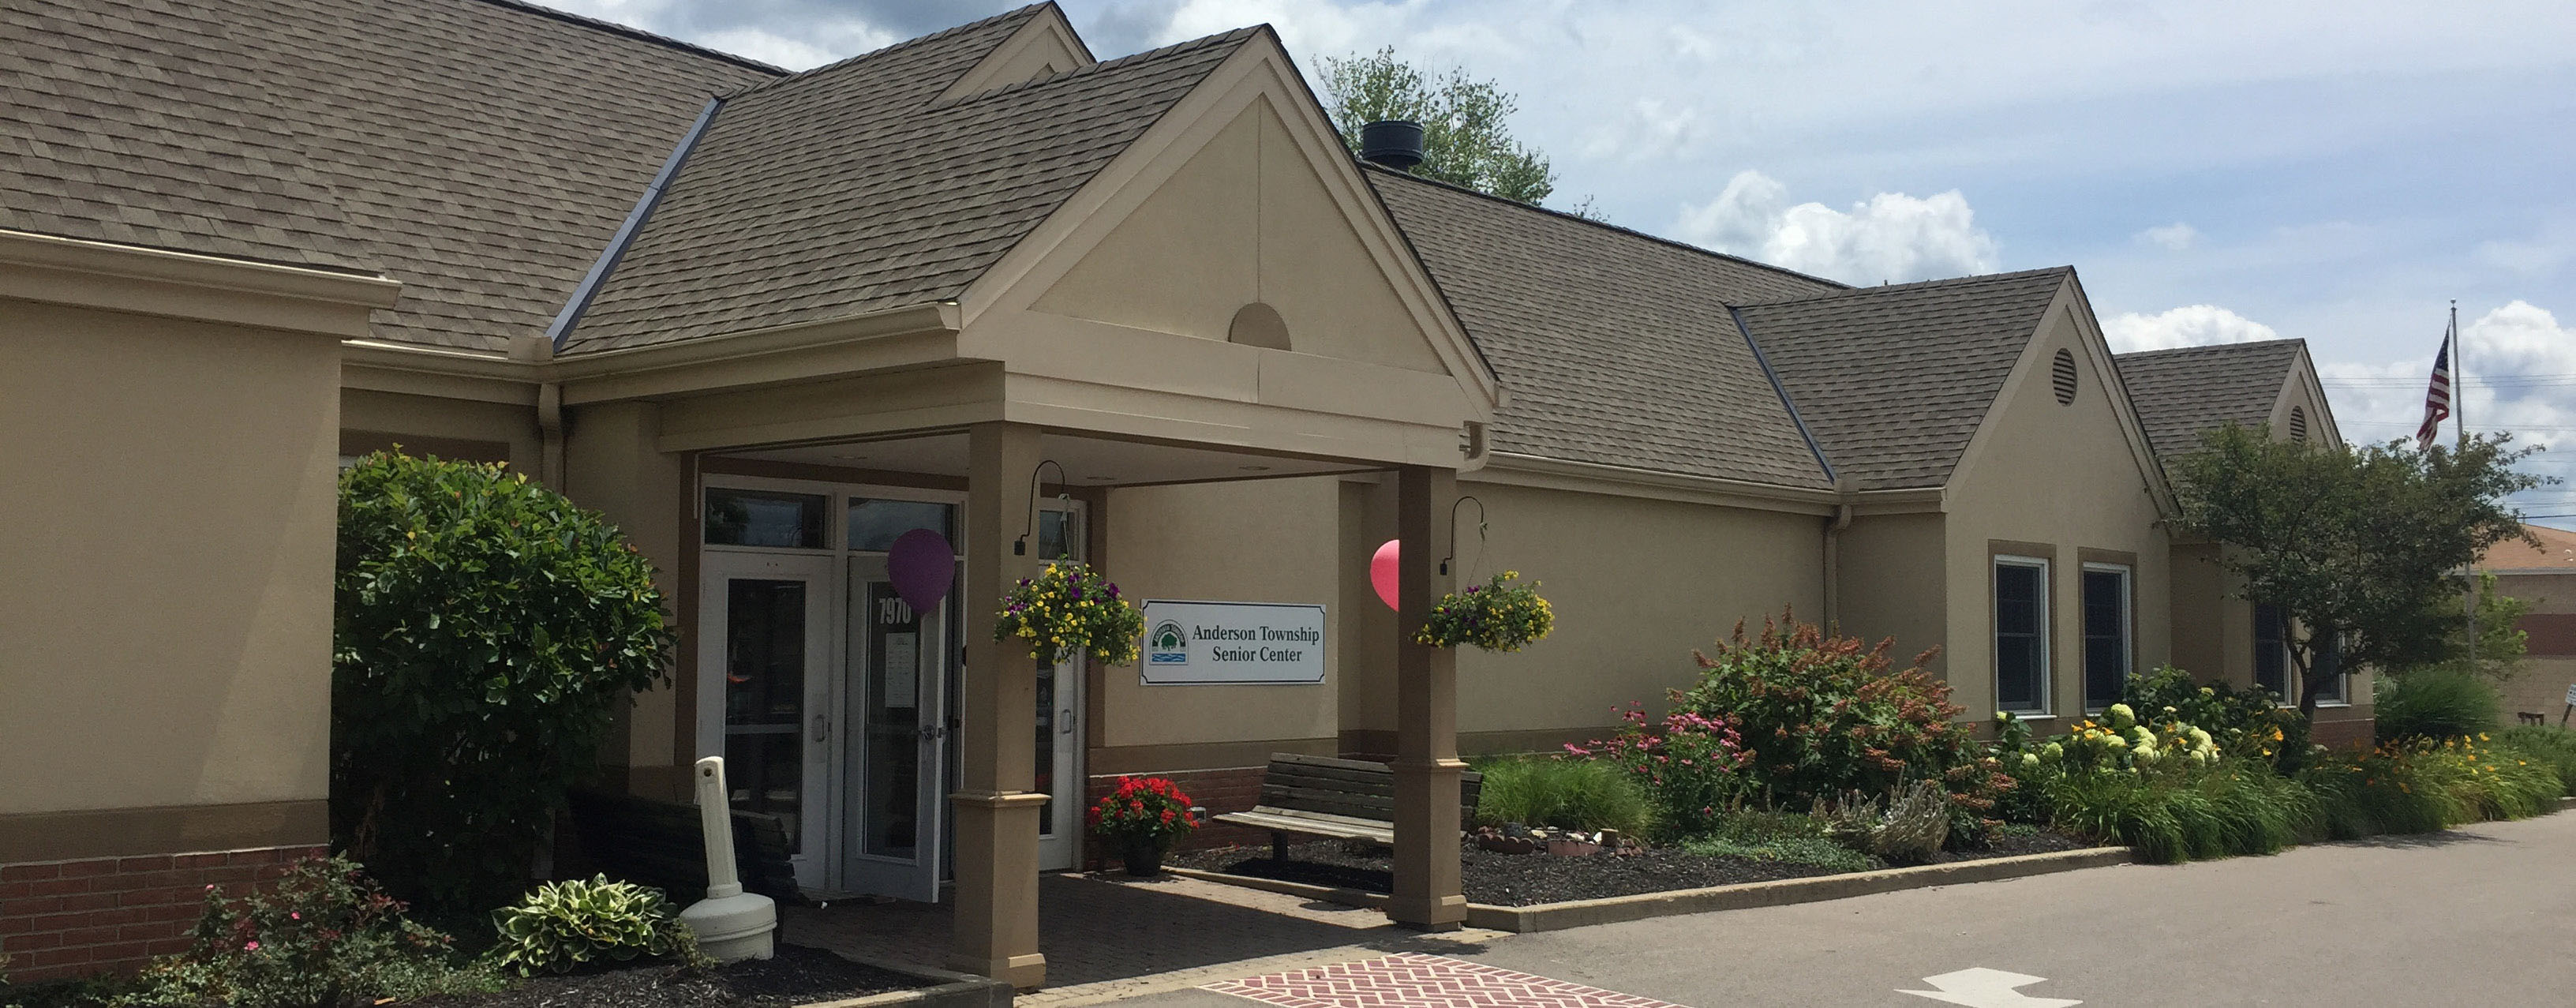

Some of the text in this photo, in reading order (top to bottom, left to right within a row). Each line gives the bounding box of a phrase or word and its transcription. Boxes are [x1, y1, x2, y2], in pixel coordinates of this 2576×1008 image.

[878, 597, 912, 624] 7970
[1192, 624, 1256, 641] Anderson
[1260, 626, 1320, 646] Township
[1212, 646, 1302, 661] Senior Center
